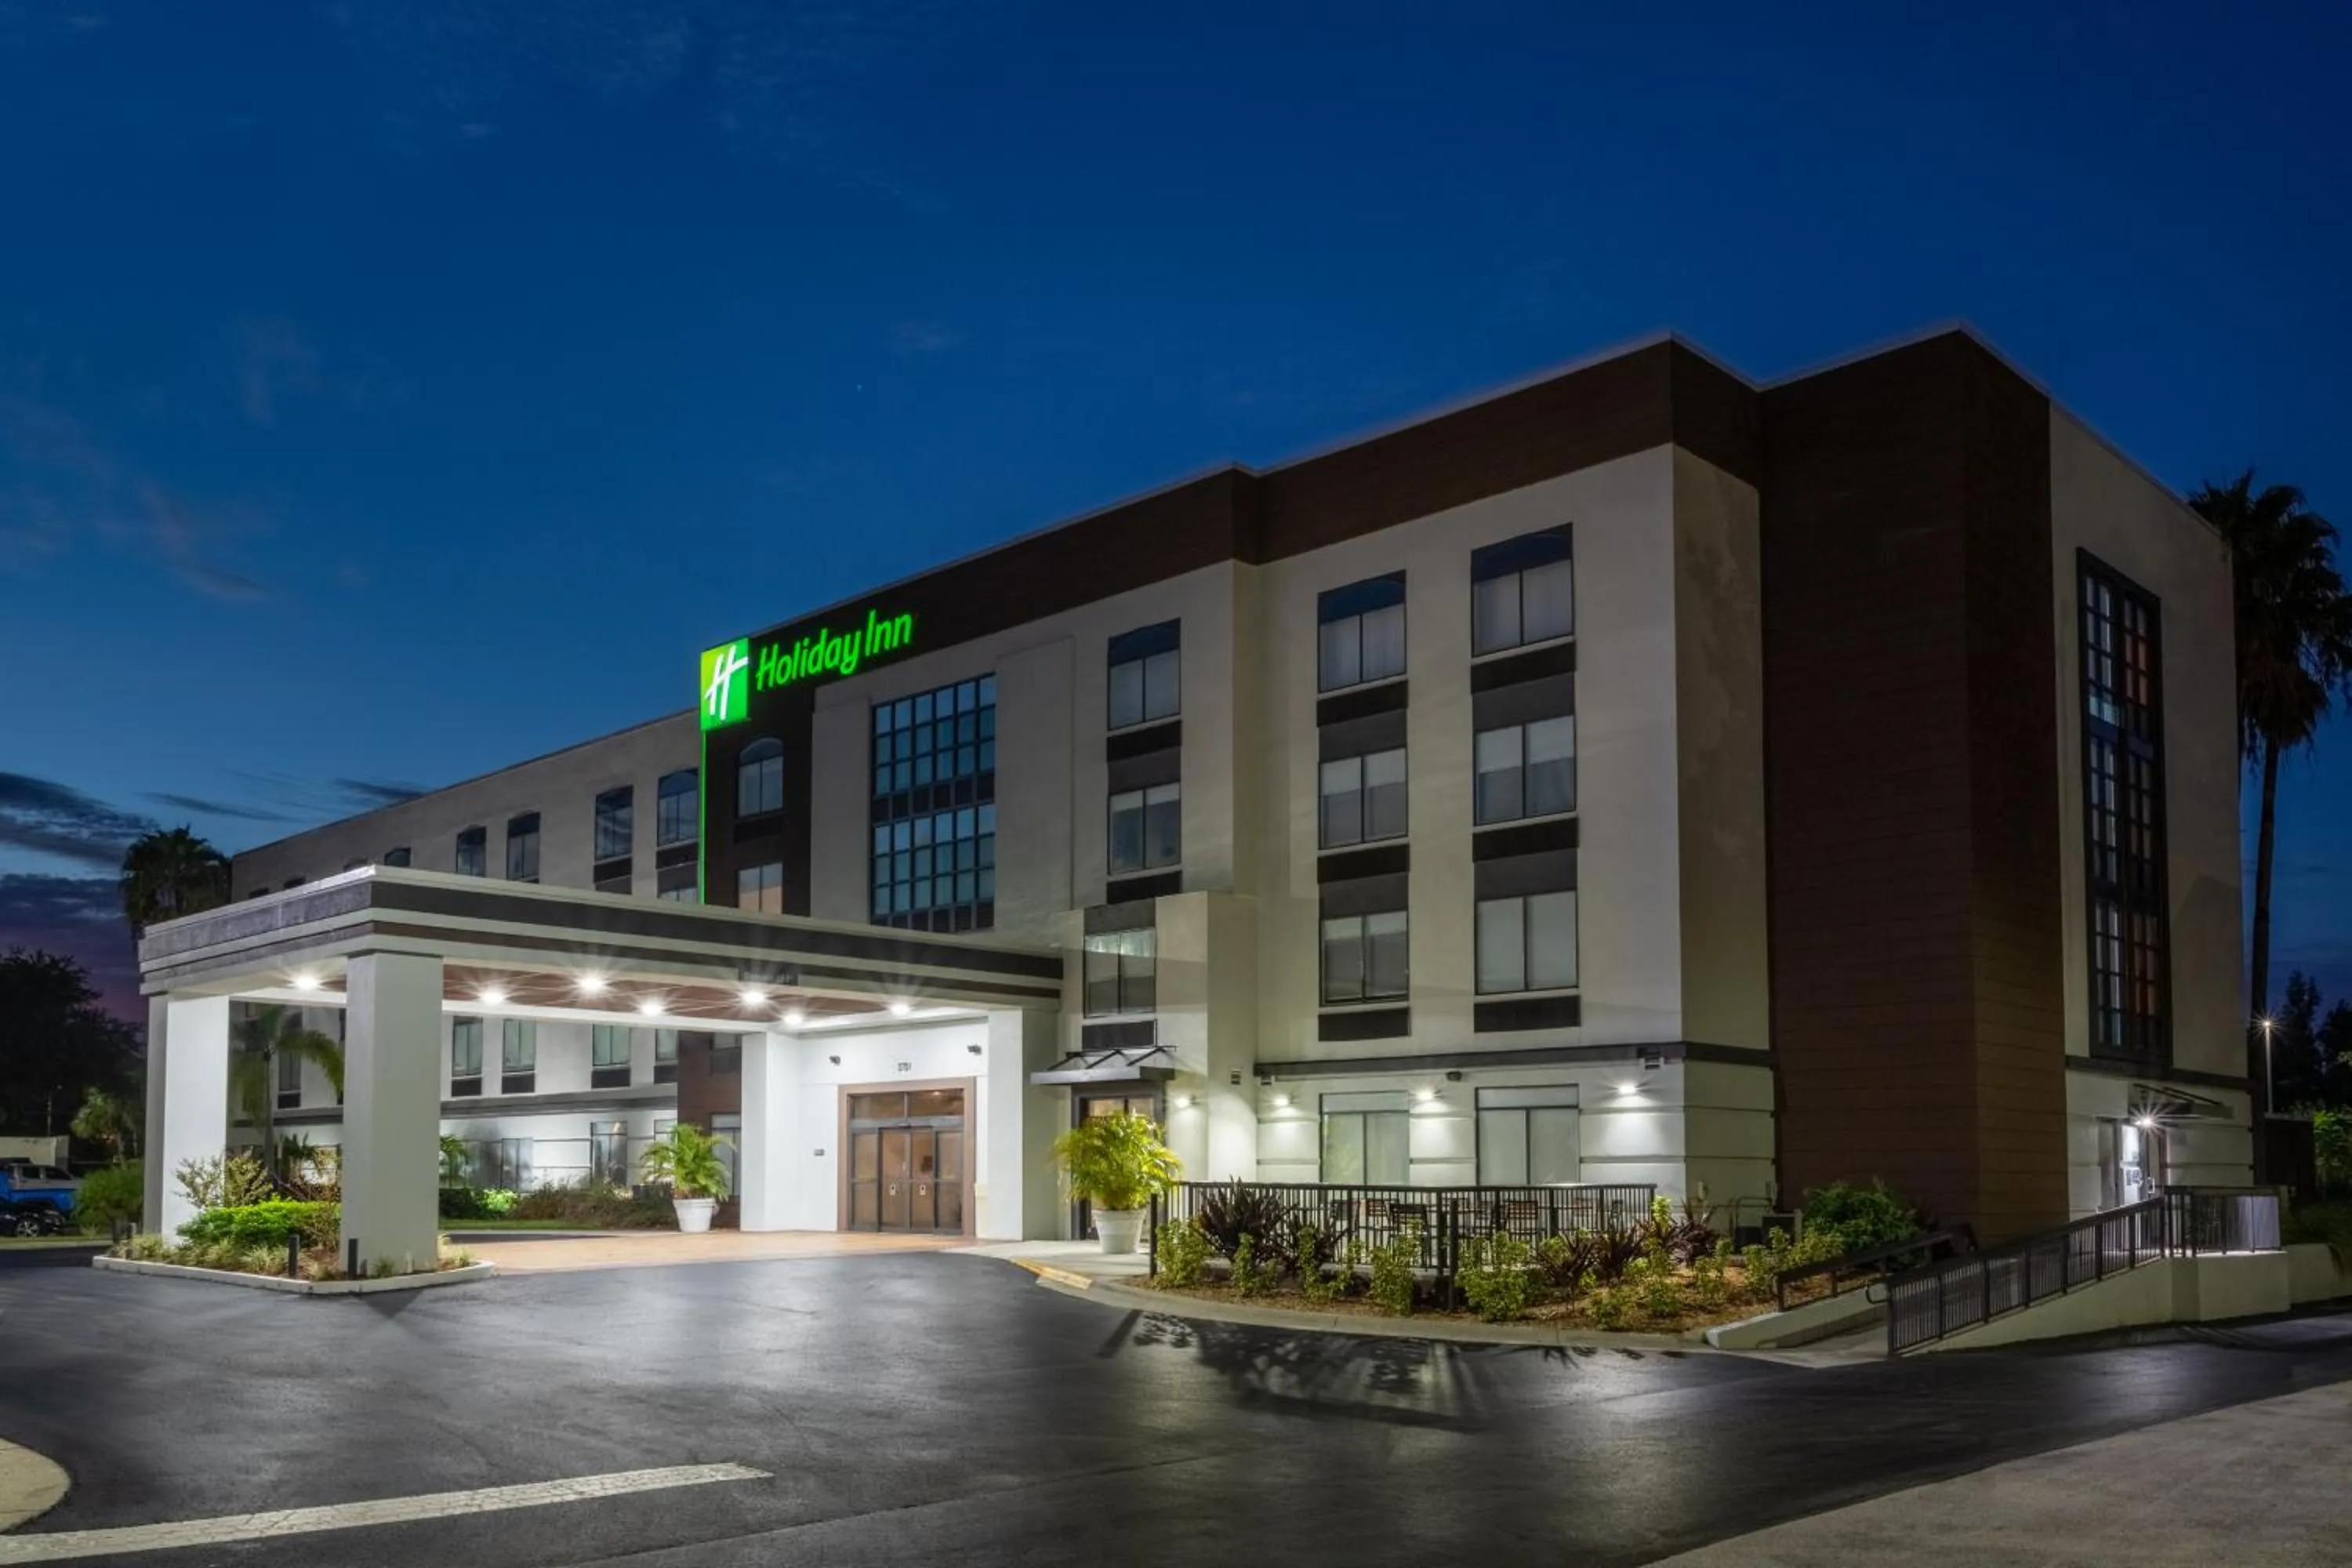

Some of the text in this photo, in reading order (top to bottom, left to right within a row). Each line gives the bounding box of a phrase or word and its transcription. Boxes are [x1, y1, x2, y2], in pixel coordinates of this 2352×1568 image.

[705, 644, 749, 720] H
[755, 609, 913, 691] Holiday Inn
